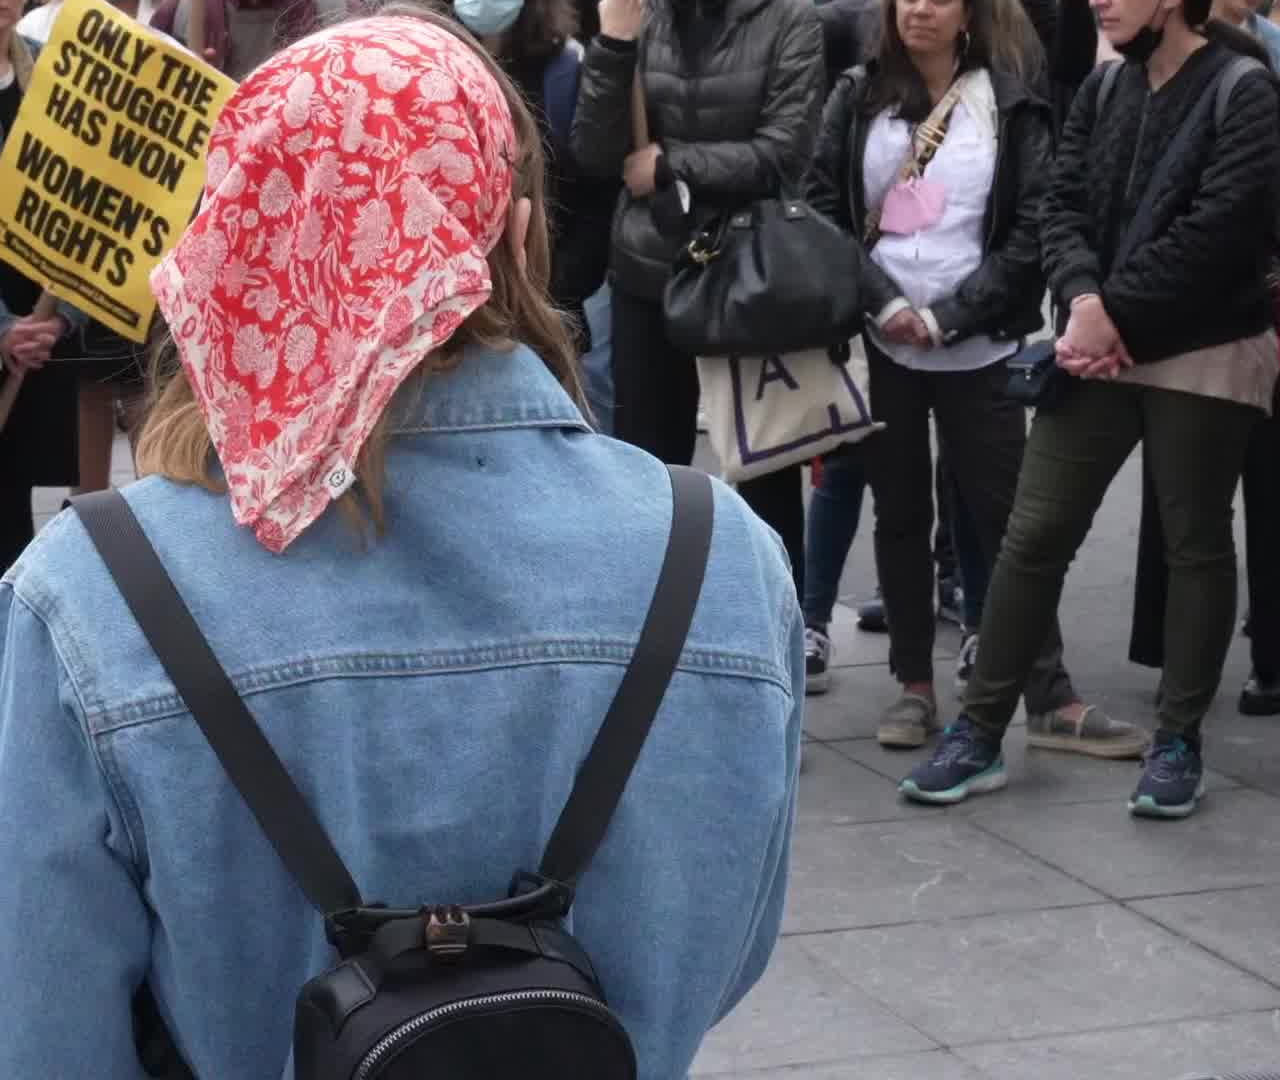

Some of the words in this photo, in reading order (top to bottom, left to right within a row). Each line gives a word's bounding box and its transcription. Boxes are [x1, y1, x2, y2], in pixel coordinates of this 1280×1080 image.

[53, 40, 210, 160] STRUGGLE
[76, 8, 154, 78] ONLY
[155, 52, 218, 117] THE
[16, 130, 170, 257] WOMEN'S
[45, 83, 108, 147] HAS
[108, 123, 186, 194] WON
[14, 187, 134, 288] RIGHTS
